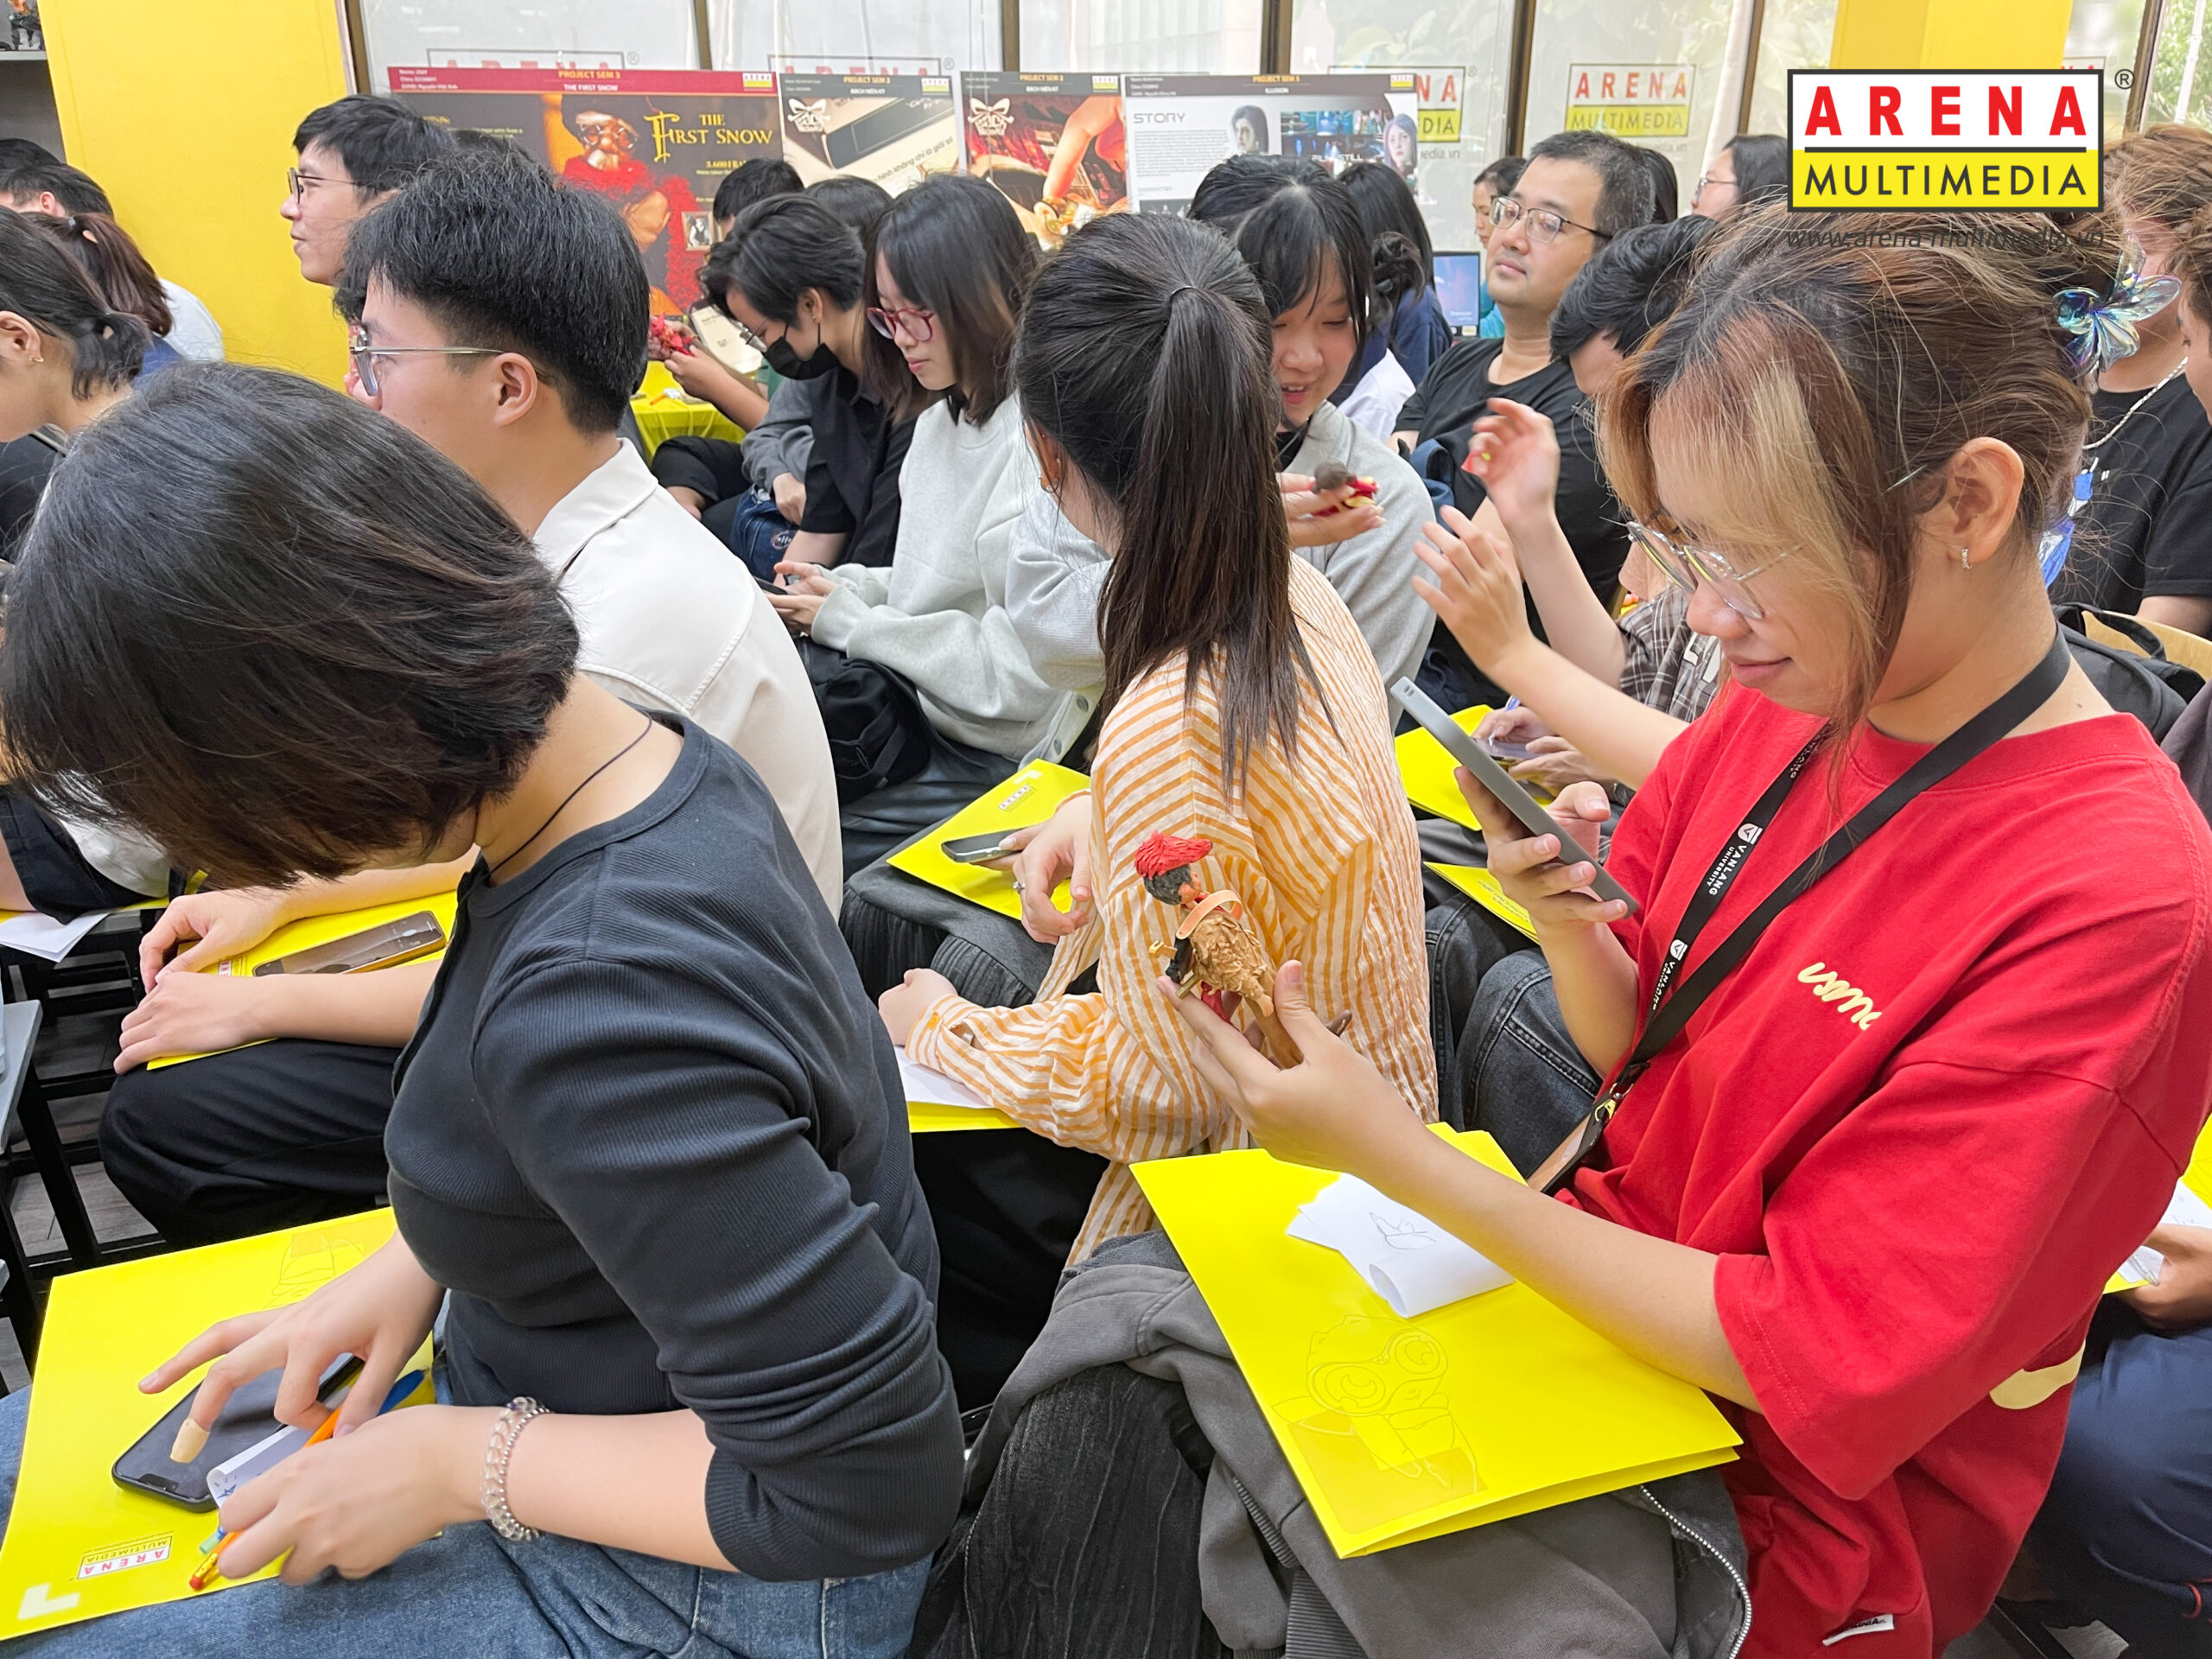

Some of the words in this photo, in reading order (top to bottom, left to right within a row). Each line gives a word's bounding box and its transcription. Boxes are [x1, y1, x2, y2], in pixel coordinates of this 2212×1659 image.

[557, 70, 594, 79] PROJECT
[1575, 72, 1687, 99] ARENA
[699, 113, 726, 126] THE
[1133, 112, 1185, 124] STORY
[1571, 111, 1684, 130] MULTIMEDIA
[643, 111, 709, 163] FIRST
[715, 129, 773, 144] SNOW
[1707, 846, 1735, 887] UNIVERSITY
[1708, 845, 1747, 896] VANLANG
[84, 1548, 165, 1575] ARENA
[86, 1539, 168, 1563] MULTIMEDIA
